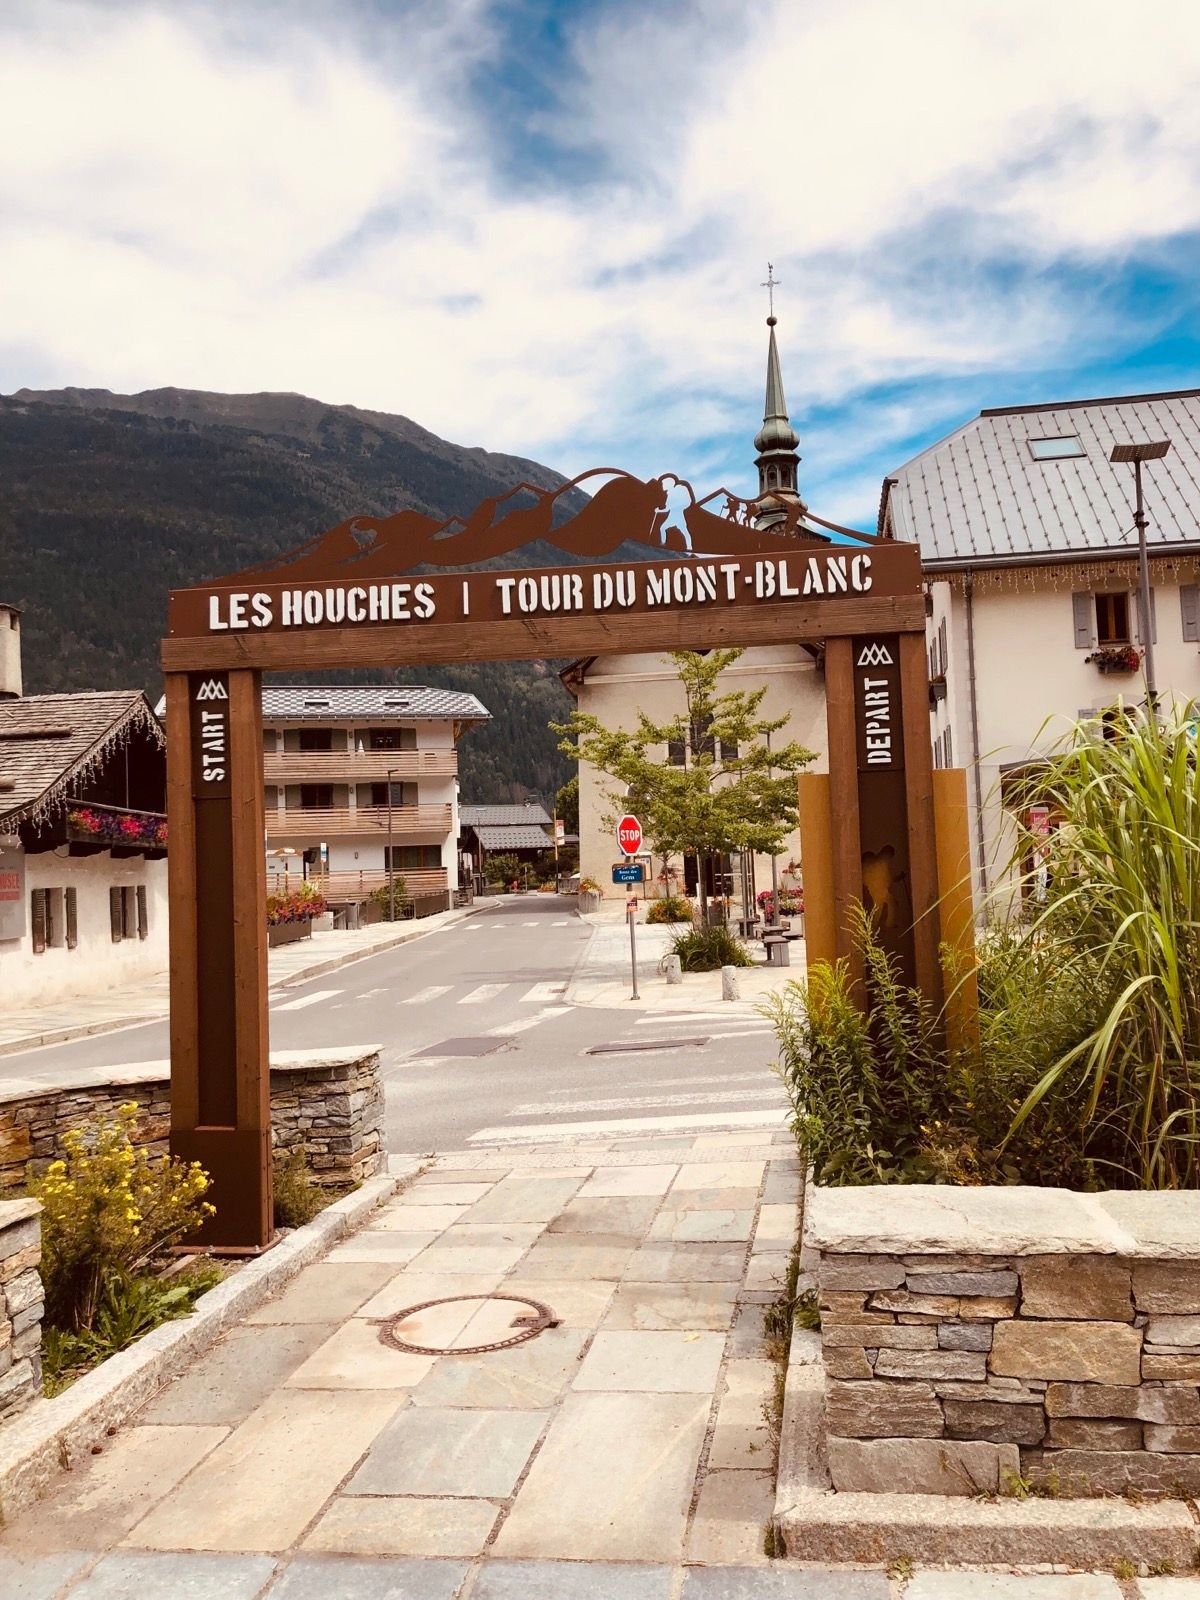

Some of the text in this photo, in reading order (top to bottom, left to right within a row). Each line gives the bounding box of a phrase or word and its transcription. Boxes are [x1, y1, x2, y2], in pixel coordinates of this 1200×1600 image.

[209, 593, 273, 630] LES
[281, 583, 436, 626] HOUCHES
[495, 573, 583, 614] TOUR
[593, 570, 636, 609] DU
[646, 554, 873, 605] MONT-BLANC
[202, 711, 225, 782] START
[864, 677, 892, 764] DEPART
[620, 830, 640, 841] STOP
